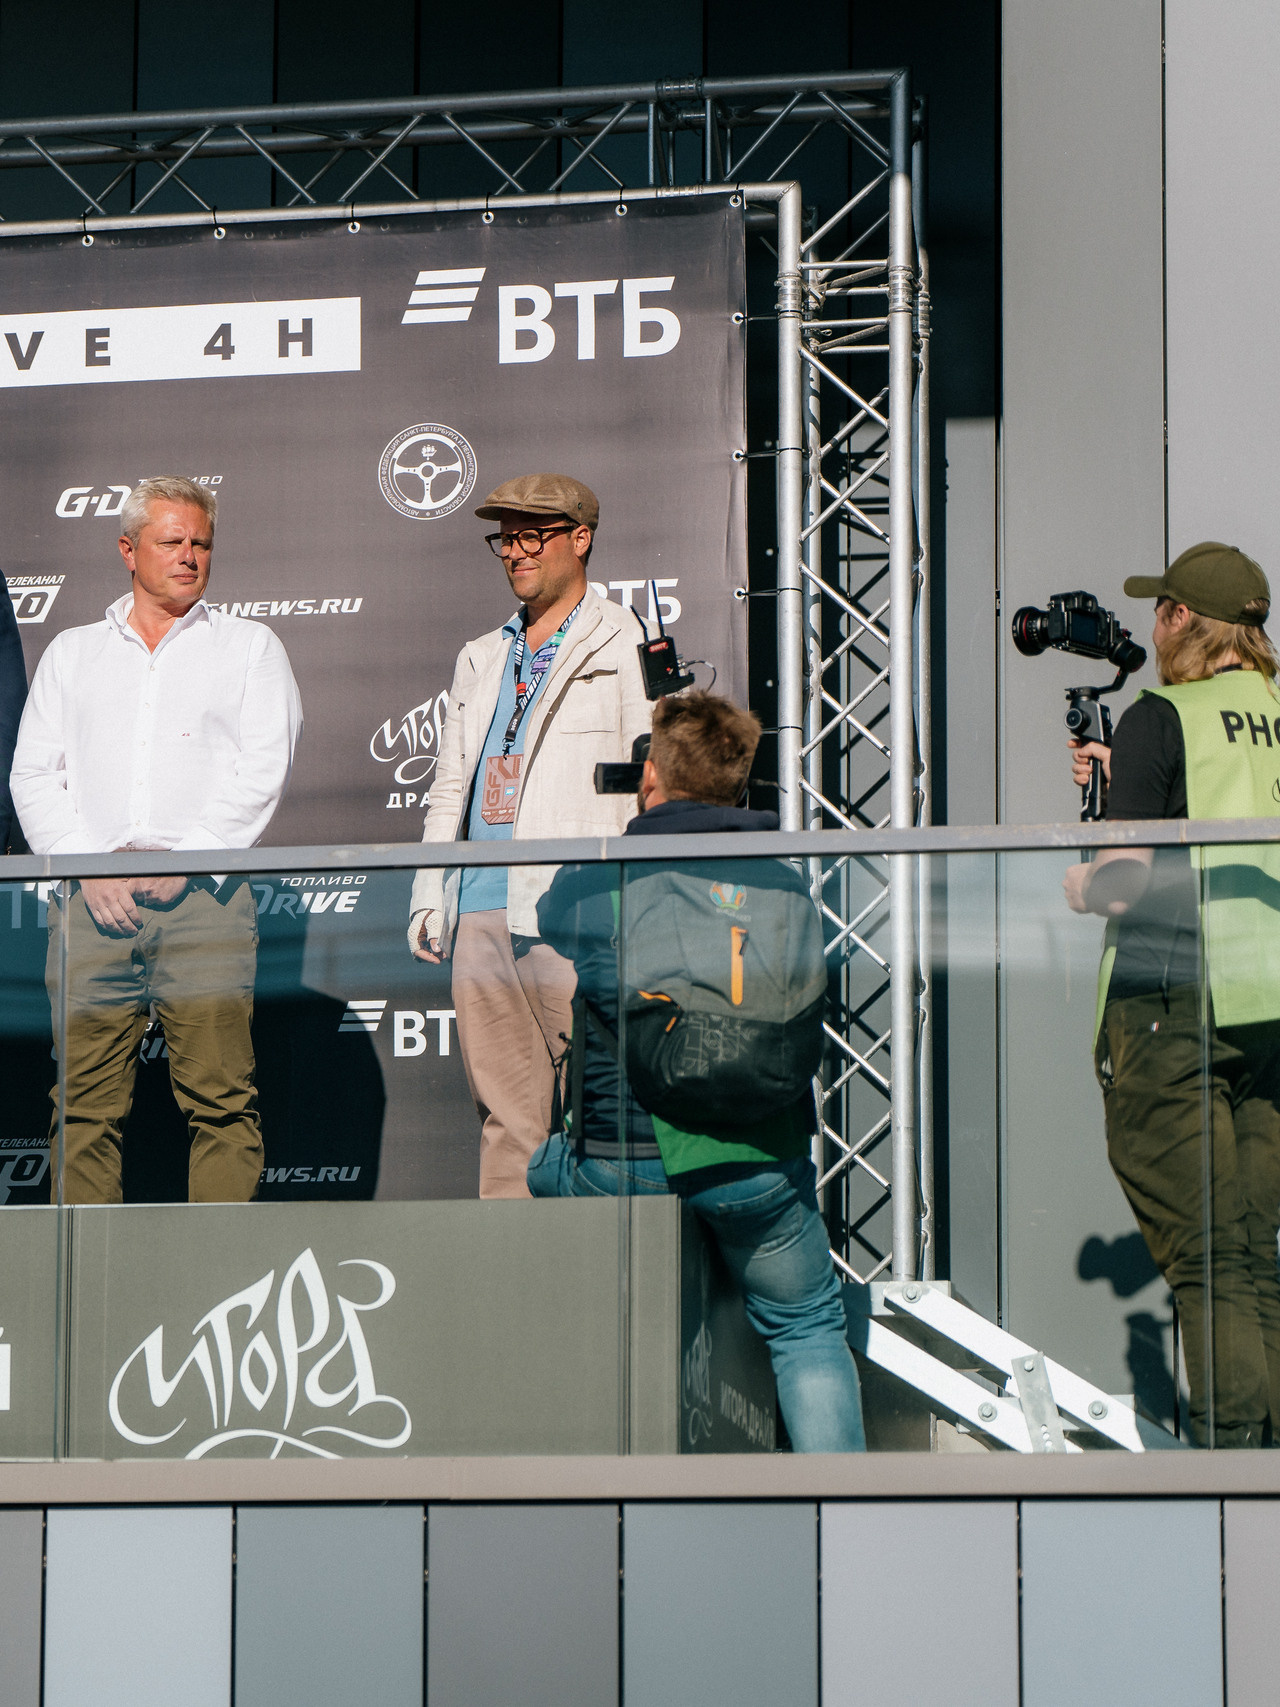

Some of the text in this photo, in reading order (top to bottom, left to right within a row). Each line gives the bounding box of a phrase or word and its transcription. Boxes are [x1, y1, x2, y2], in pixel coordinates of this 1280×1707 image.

[498, 276, 682, 364] ВТБ
[5, 575, 66, 586] ТЕЛЕКАНАЛ
[386, 792, 430, 808] ДРА
[280, 875, 367, 887] ТОПЛИВО
[394, 1009, 456, 1057] ВТ
